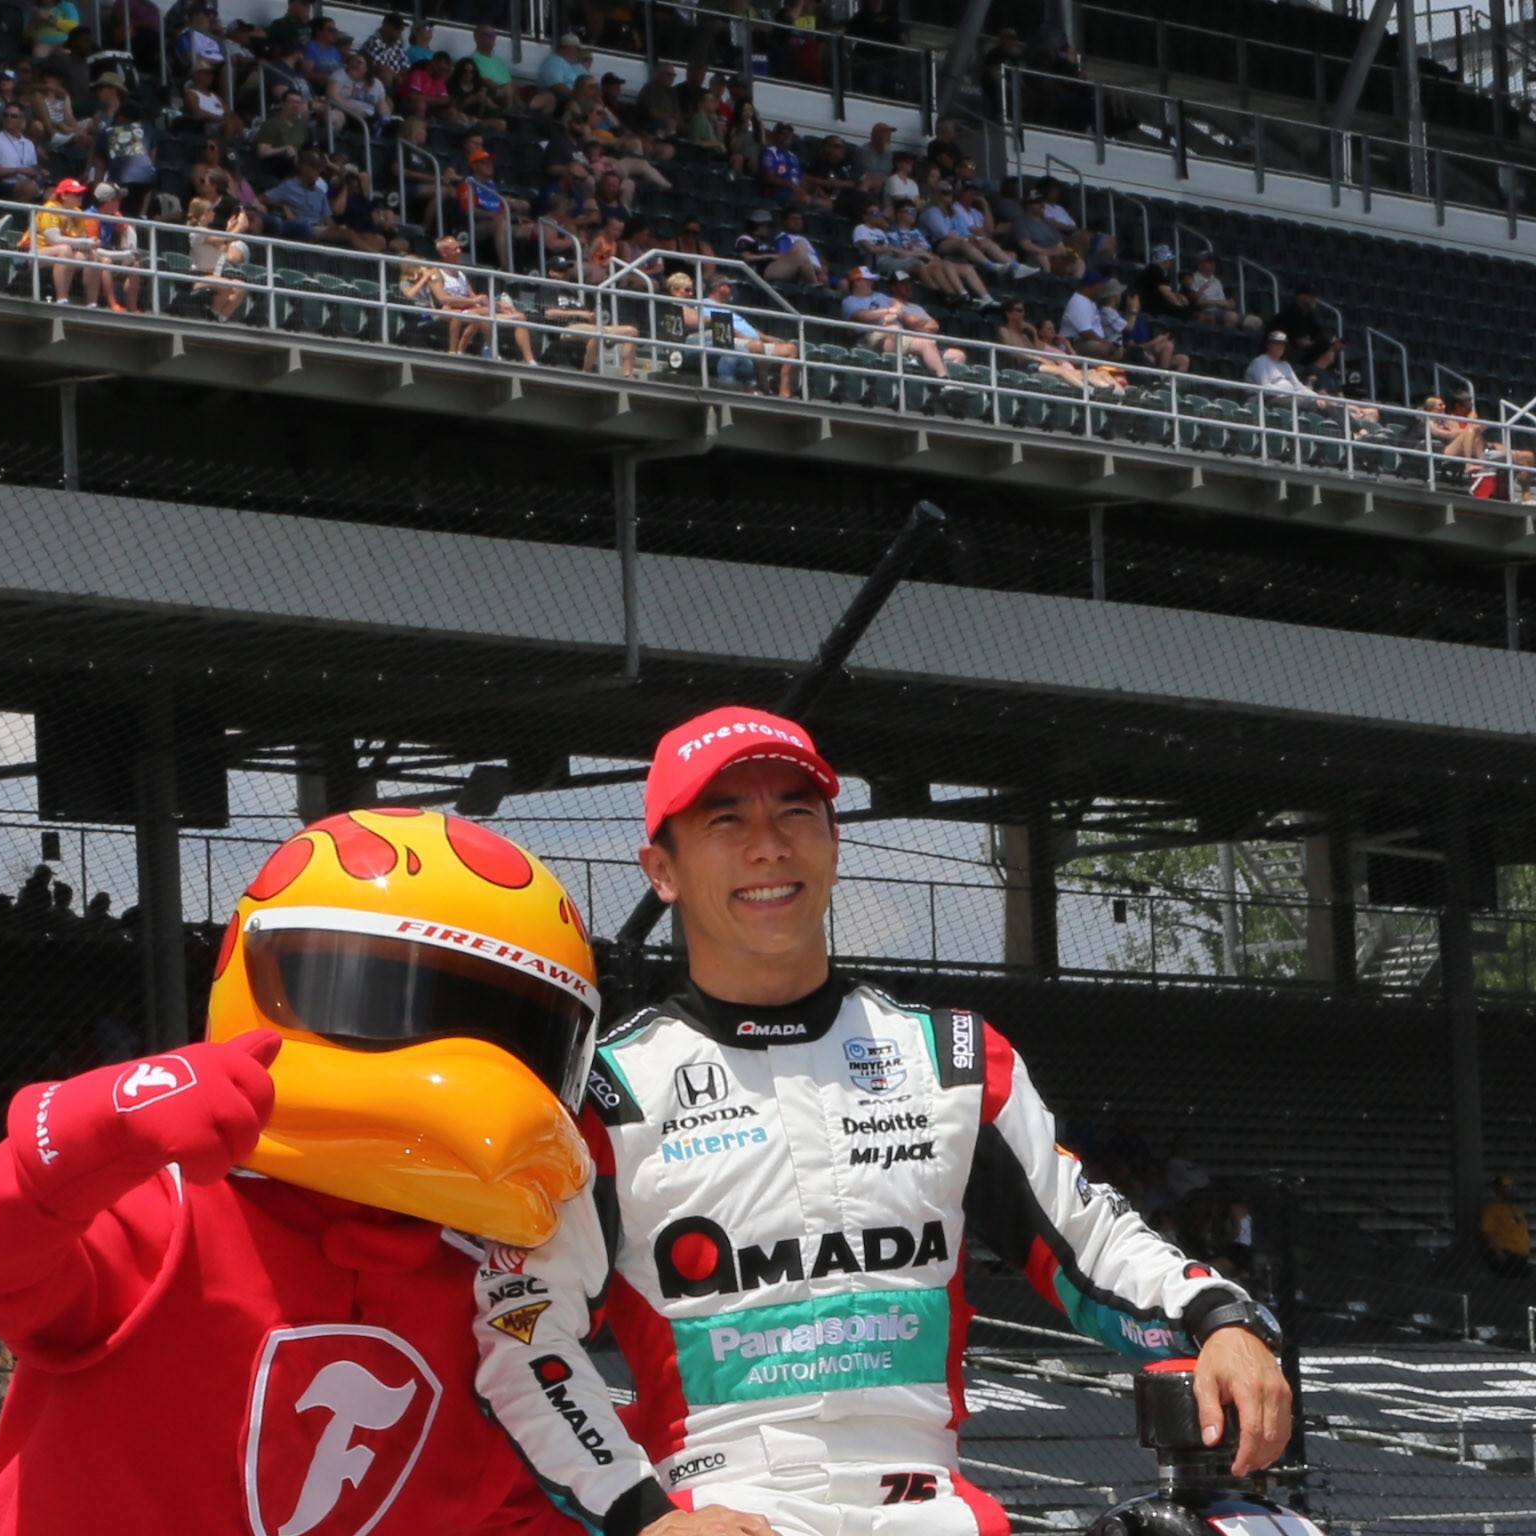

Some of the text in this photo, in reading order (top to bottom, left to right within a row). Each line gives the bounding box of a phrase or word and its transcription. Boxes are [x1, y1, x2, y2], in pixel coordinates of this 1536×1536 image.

[678, 721, 804, 762] Firestone
[396, 919, 590, 998] FIREHAWK
[736, 1021, 807, 1036] AMADA
[661, 1104, 760, 1136] HONDA
[661, 1126, 768, 1164] Niterra
[849, 1140, 936, 1170] MI-JACK
[654, 1215, 949, 1300] AMADA
[709, 1305, 920, 1363] Panasonic
[747, 1350, 893, 1386] AUTOMOTIVE
[528, 1354, 614, 1466] AMADA
[669, 1452, 726, 1484] sparco
[879, 1472, 937, 1505] 75
